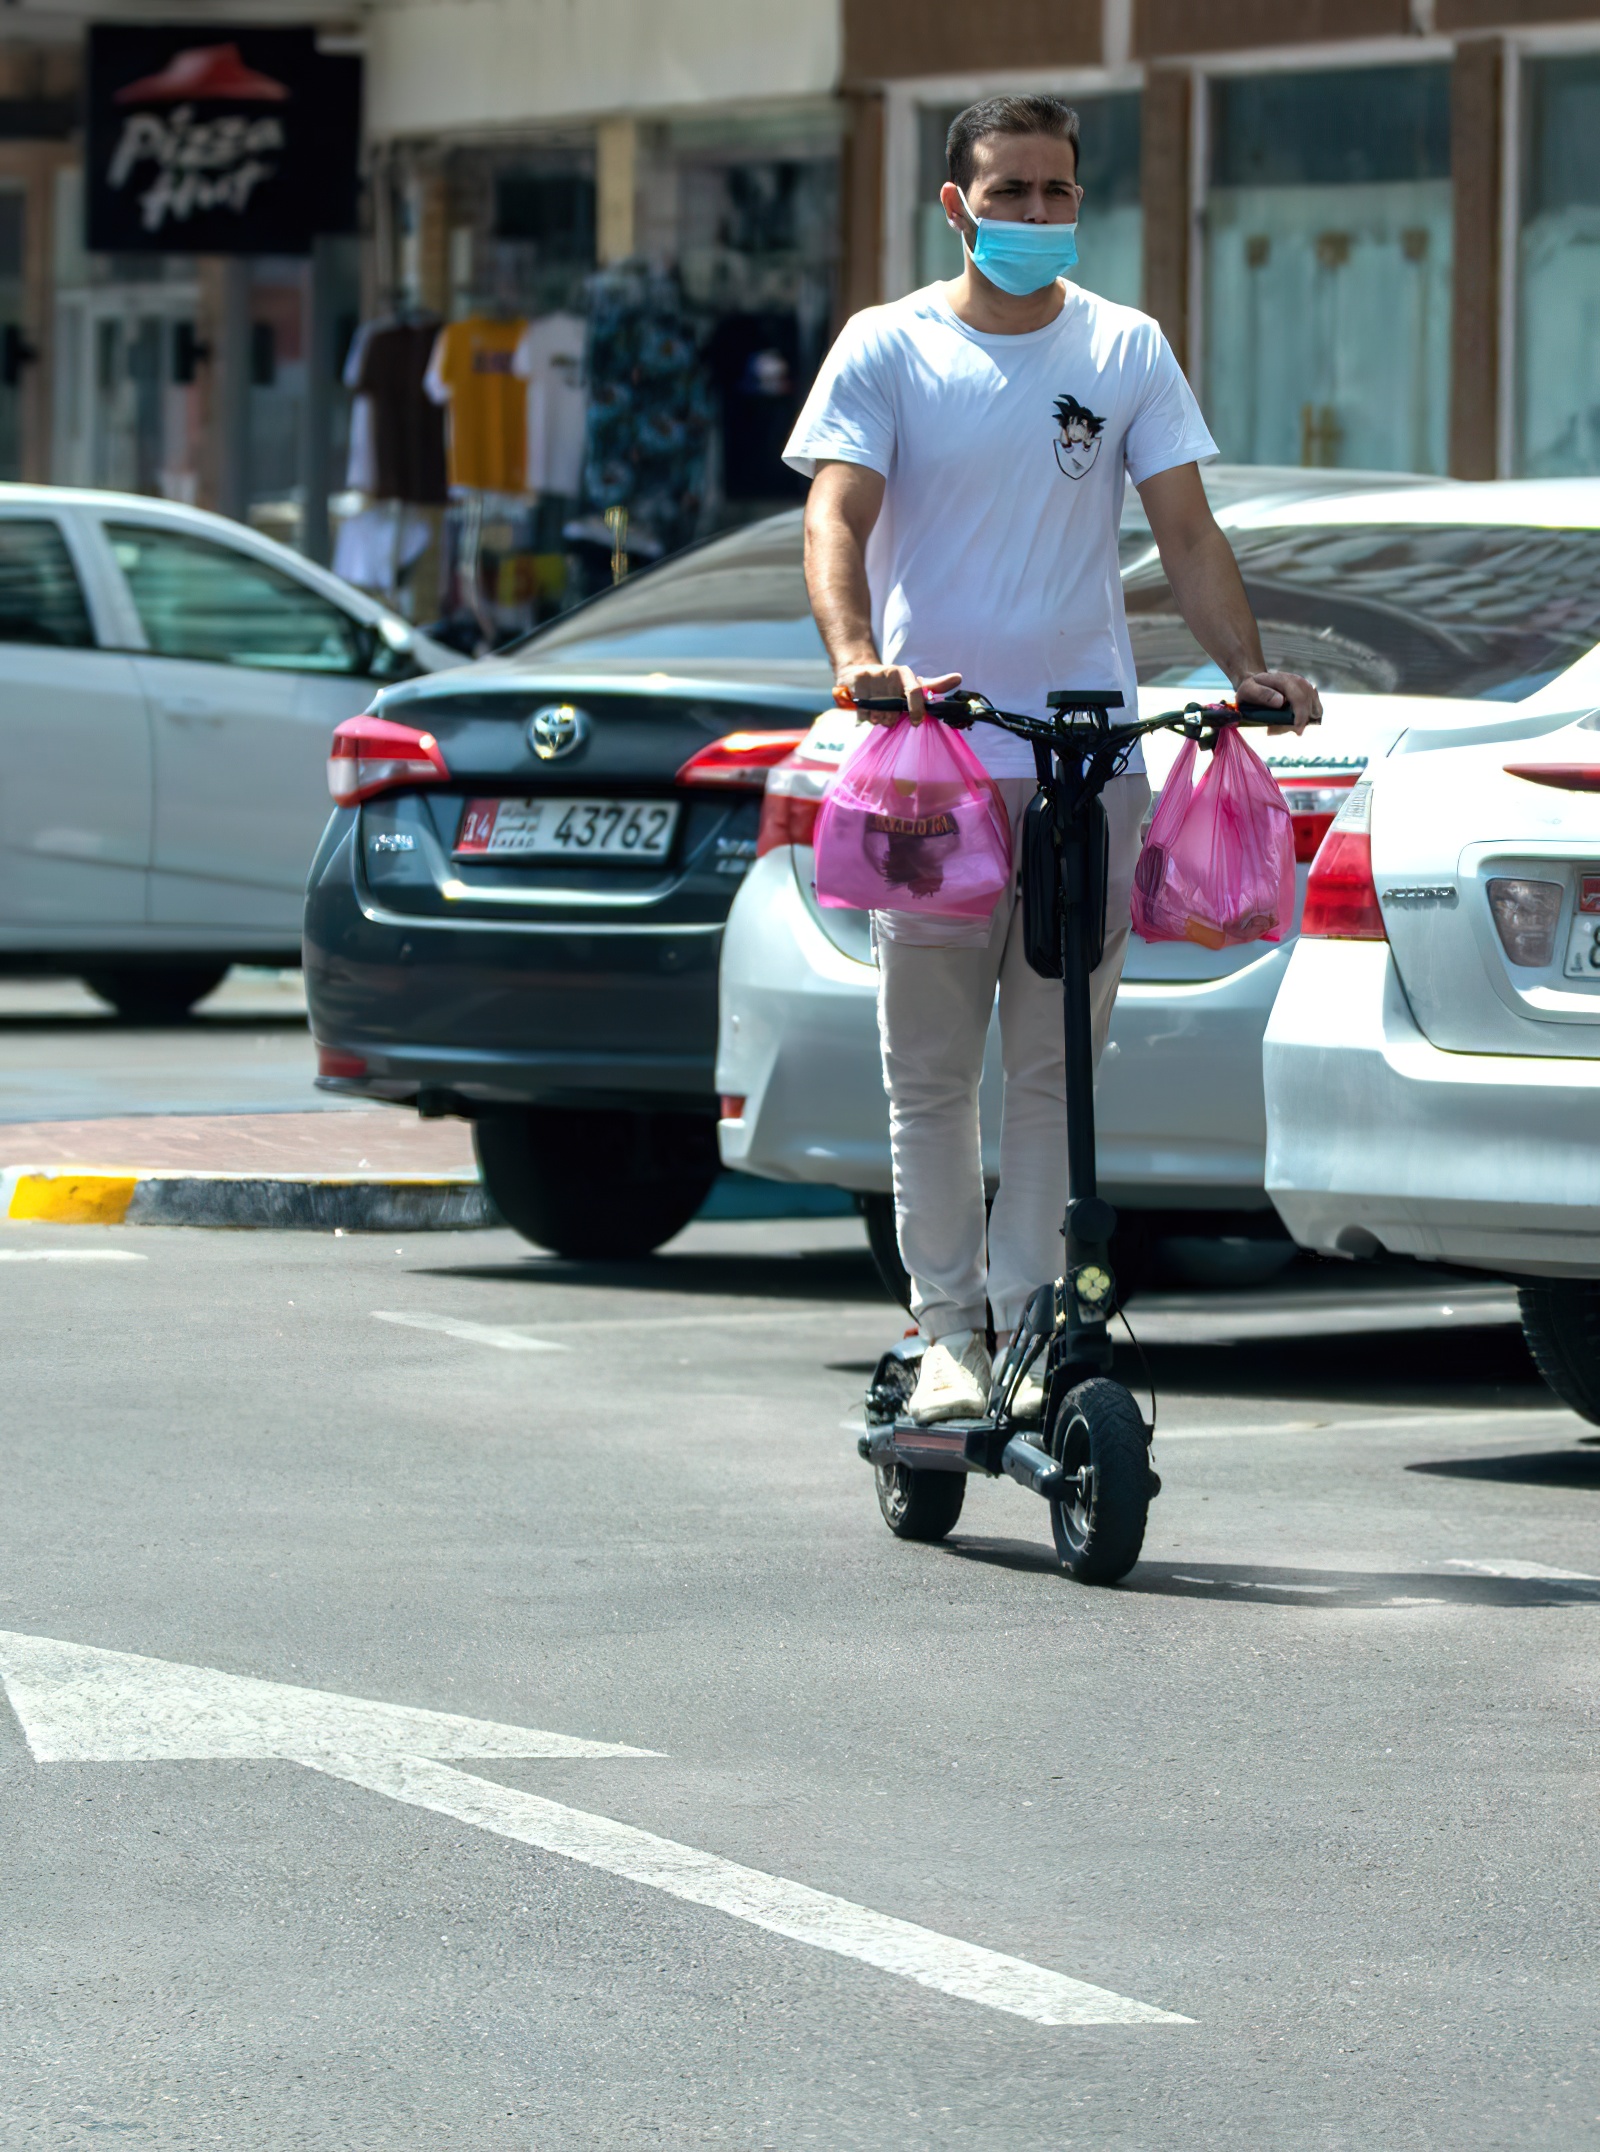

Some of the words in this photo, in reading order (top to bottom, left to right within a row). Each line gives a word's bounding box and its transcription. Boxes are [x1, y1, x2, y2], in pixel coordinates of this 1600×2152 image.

[107, 103, 283, 189] Pizza
[140, 160, 275, 232] Hut
[554, 804, 667, 849] 43762
